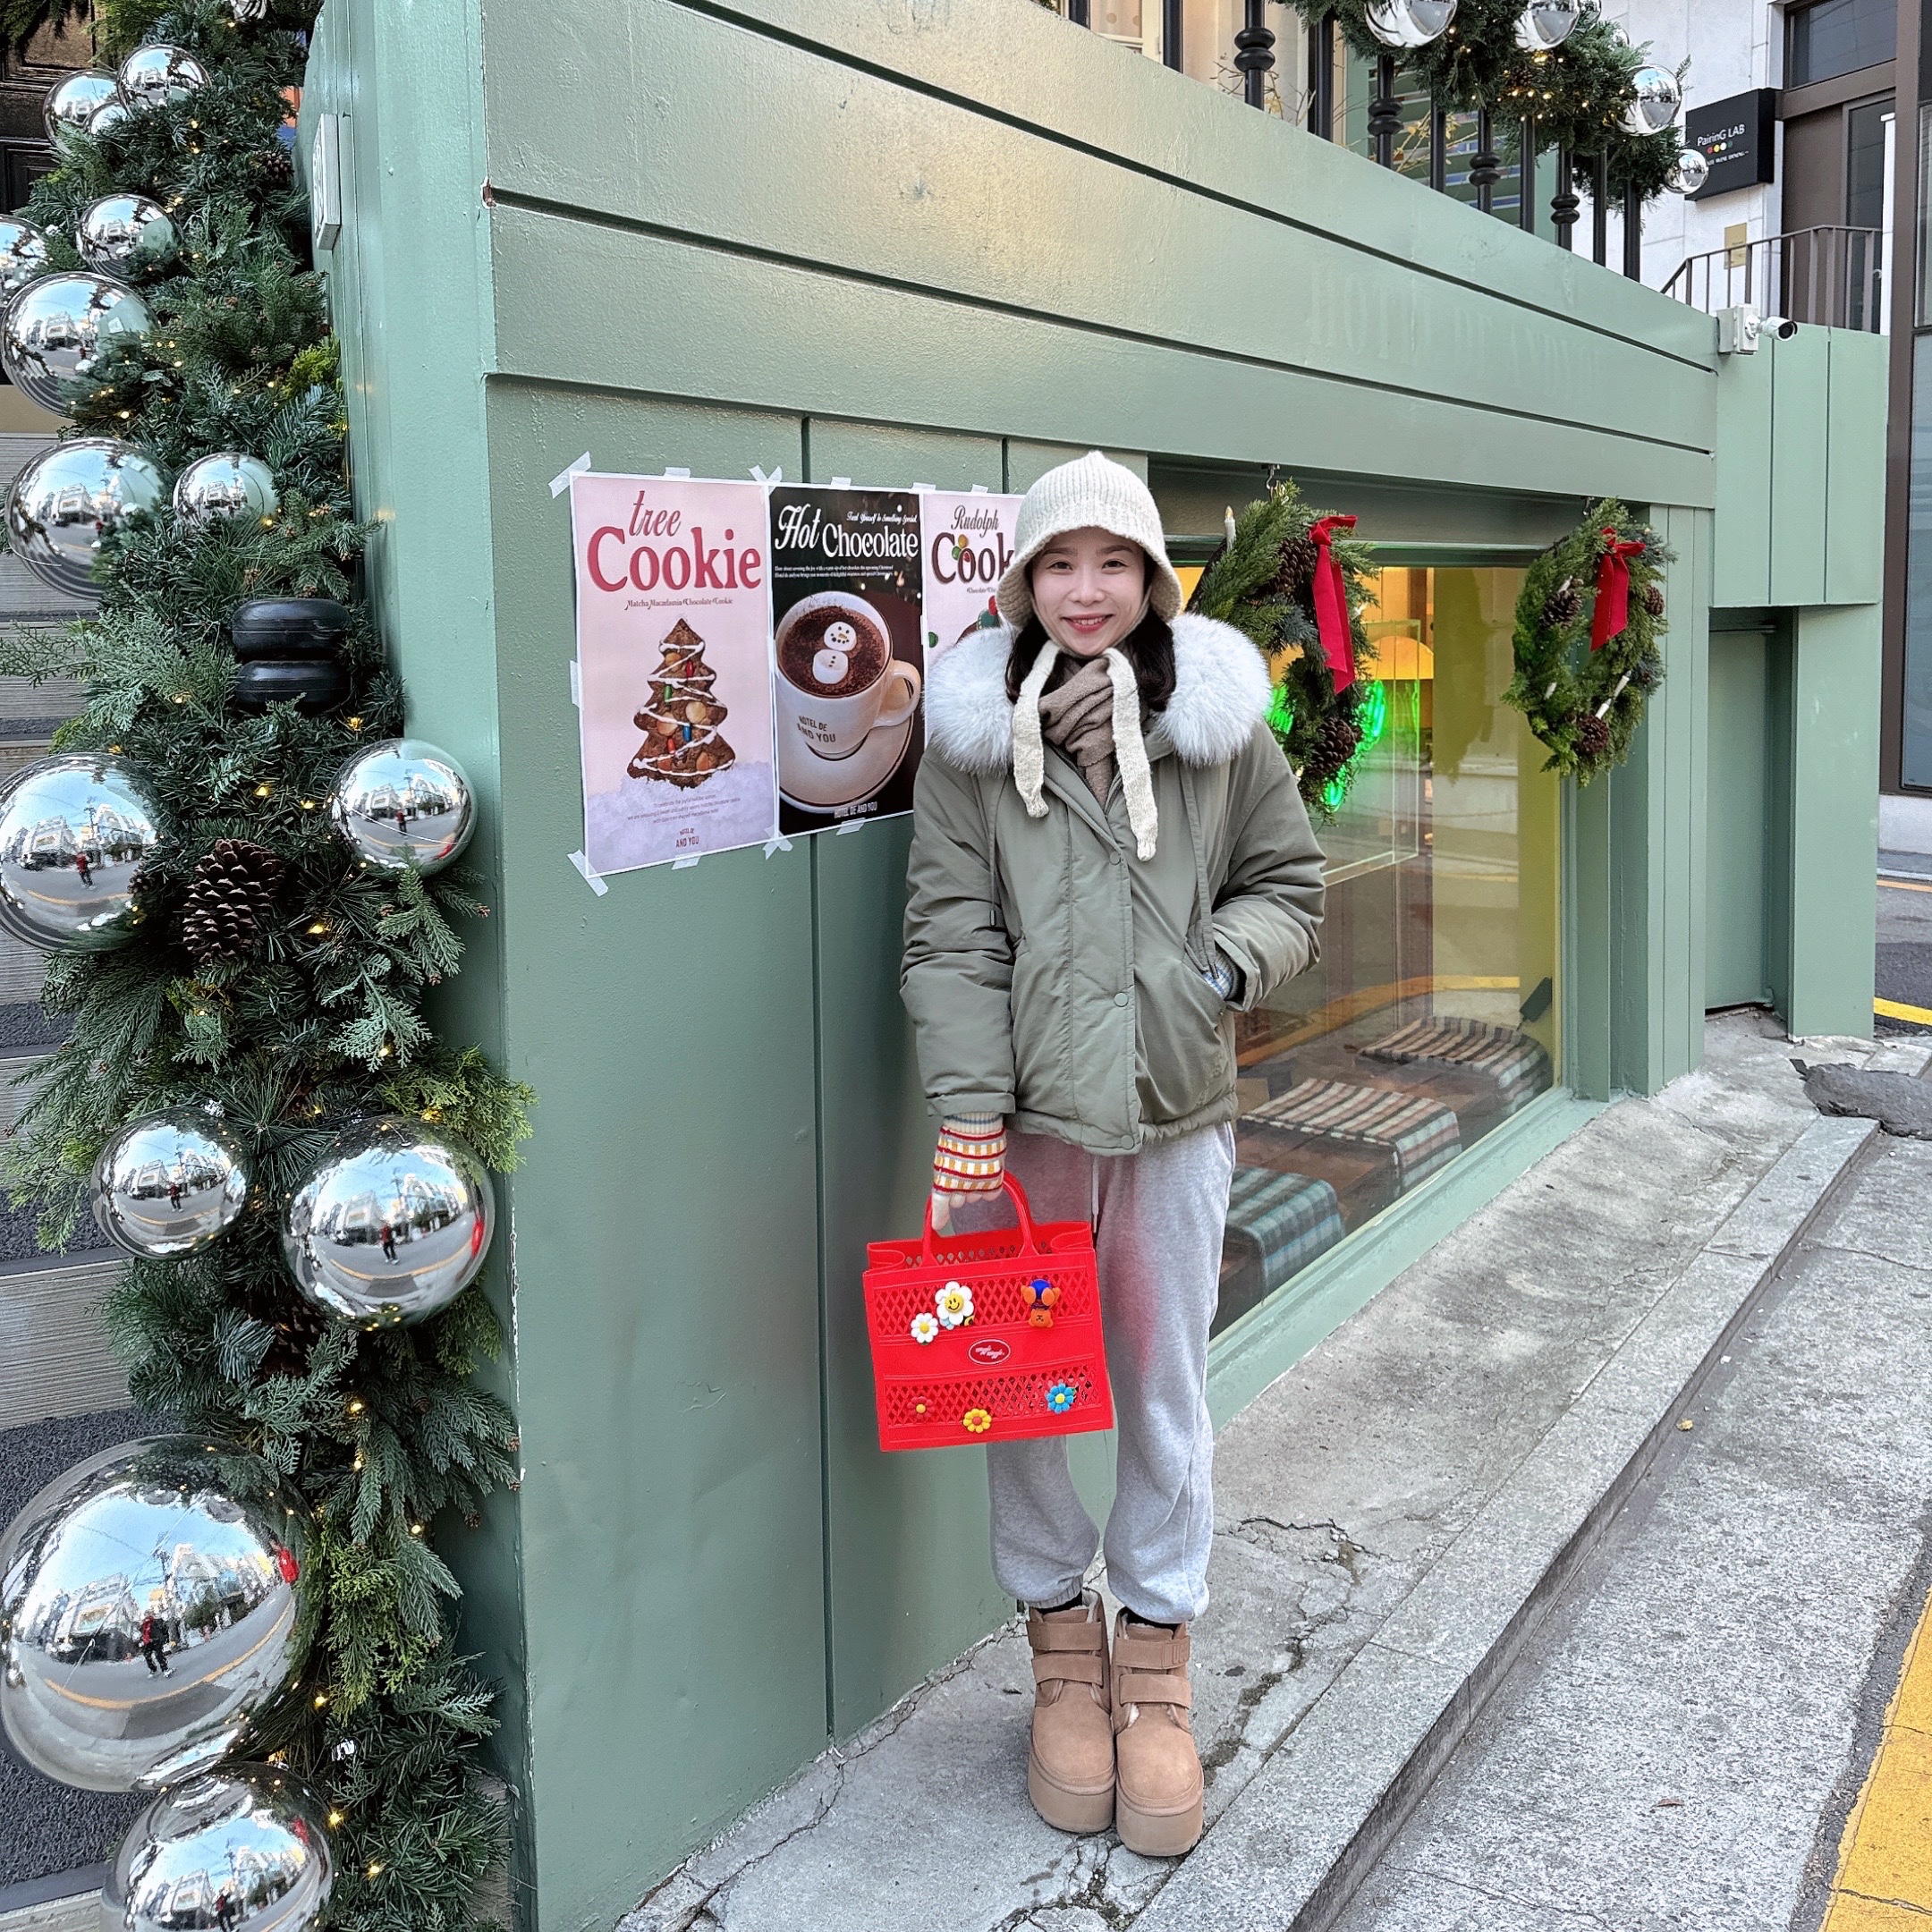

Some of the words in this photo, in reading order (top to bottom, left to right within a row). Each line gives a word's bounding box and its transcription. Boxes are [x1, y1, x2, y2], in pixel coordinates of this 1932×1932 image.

[1697, 129, 1726, 147] PairinG
[1728, 123, 1745, 138] LAB
[629, 490, 681, 536] tree
[775, 503, 821, 550] Hot
[951, 504, 999, 538] Rudolph
[822, 523, 919, 557] Chocolate
[587, 526, 761, 592] Cookie
[932, 531, 1014, 585] Cook
[624, 599, 648, 610] Matcha
[682, 597, 712, 606] Chocolate
[816, 733, 836, 742] YOU
[818, 722, 828, 732] DE
[676, 837, 687, 848] AND
[688, 835, 699, 845] YOU
